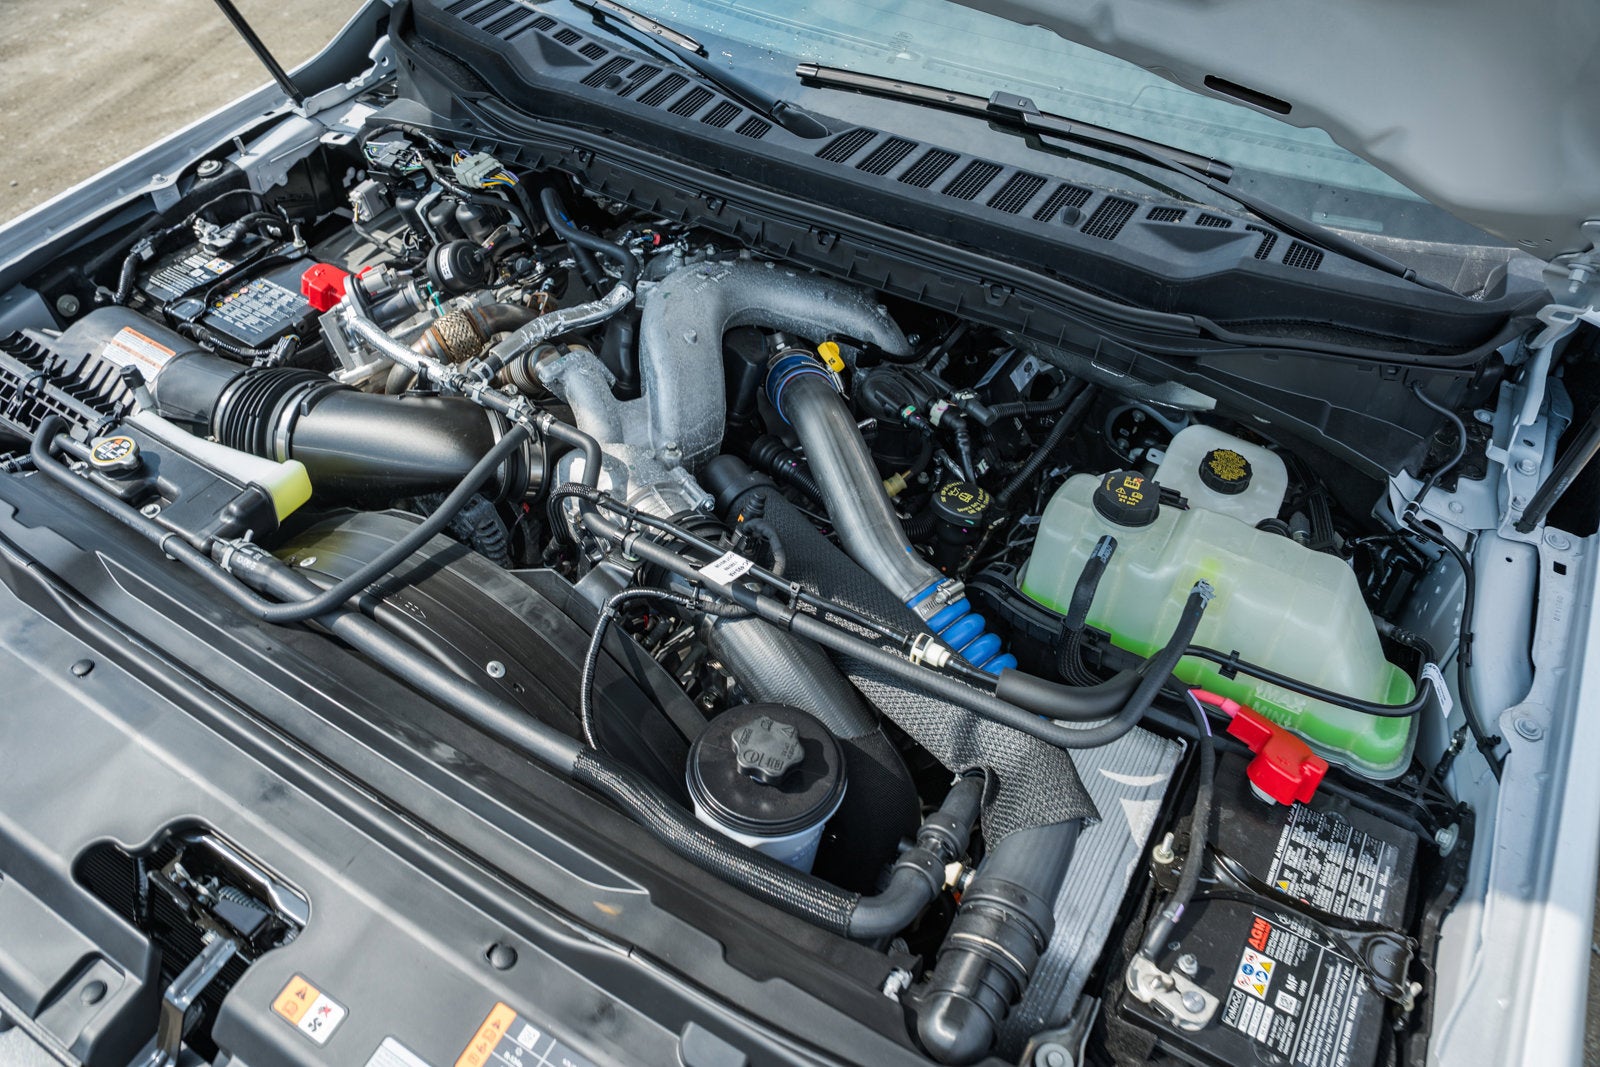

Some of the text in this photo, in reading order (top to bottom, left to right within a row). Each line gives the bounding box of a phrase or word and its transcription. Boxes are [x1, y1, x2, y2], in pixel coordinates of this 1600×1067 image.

[1262, 685, 1306, 712] MAX
[1247, 916, 1269, 950] AGM
[1225, 991, 1243, 1025] FoMoCo
